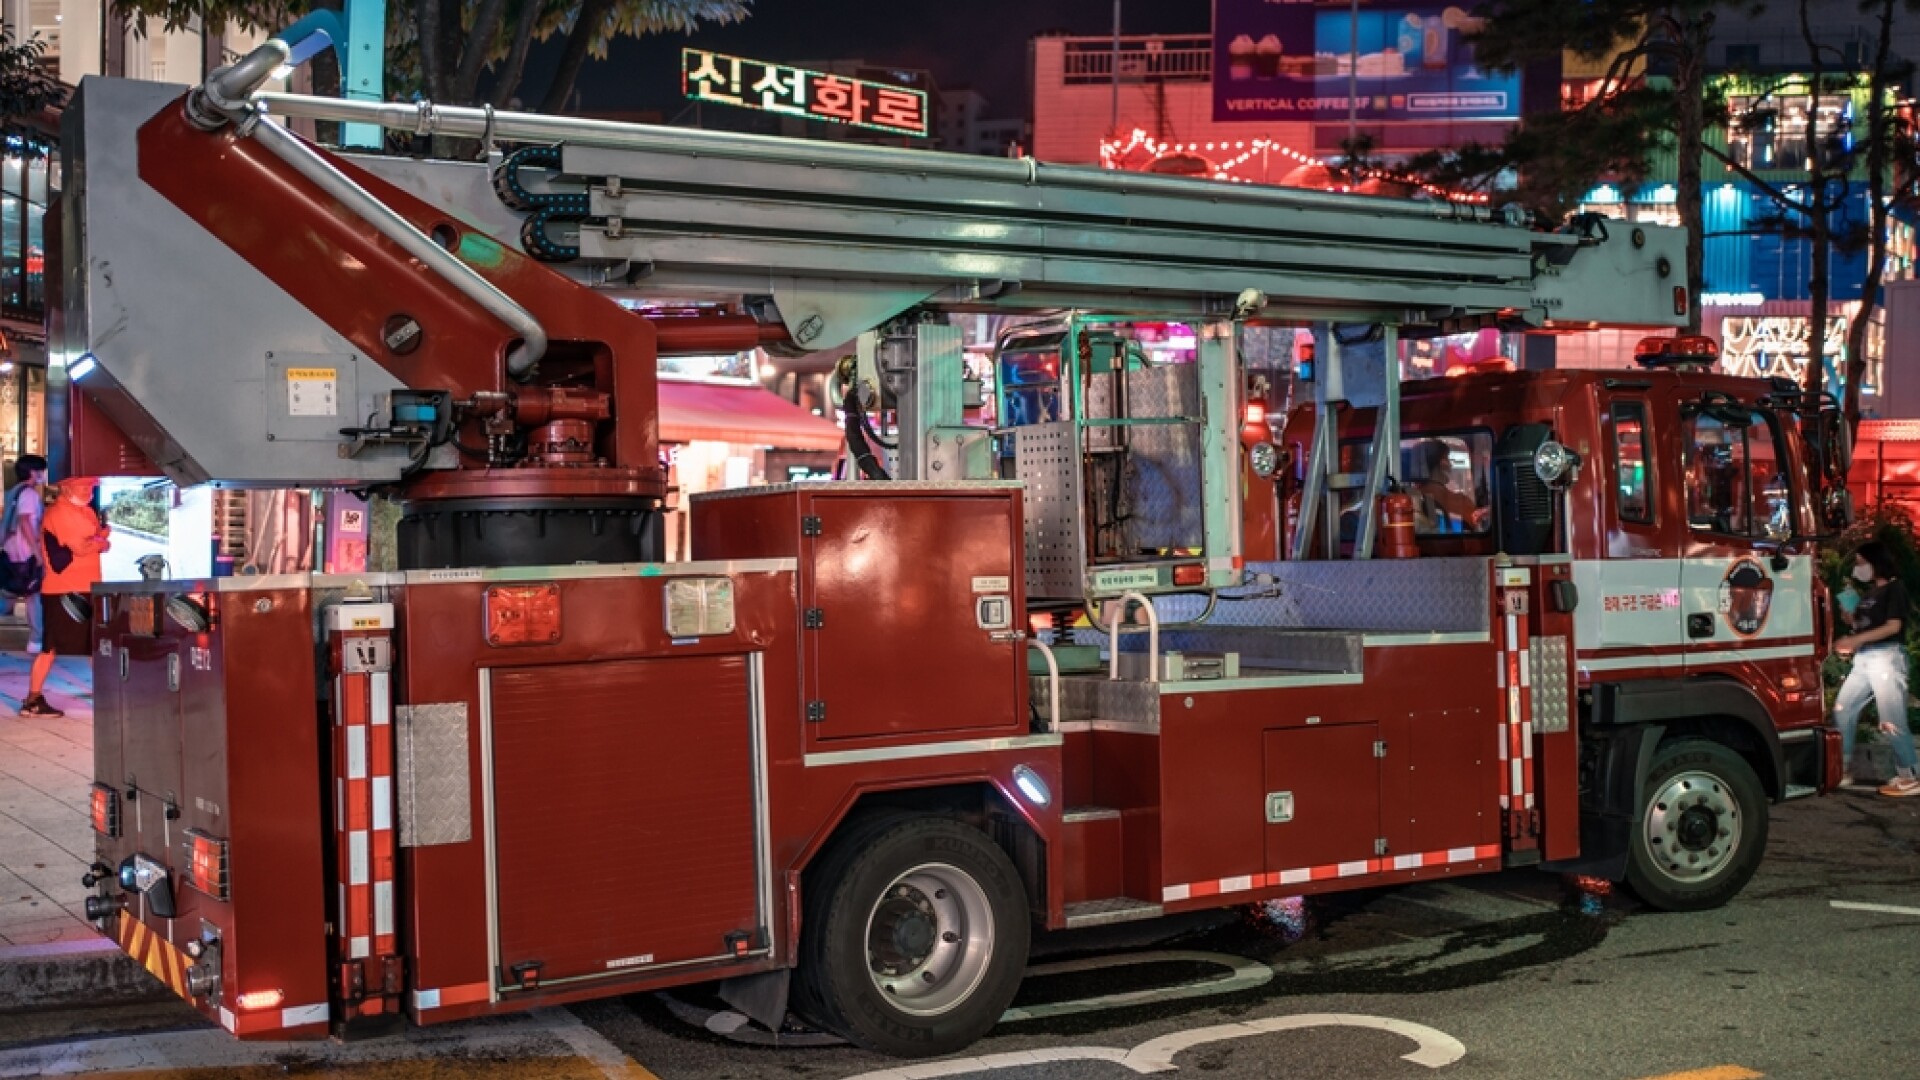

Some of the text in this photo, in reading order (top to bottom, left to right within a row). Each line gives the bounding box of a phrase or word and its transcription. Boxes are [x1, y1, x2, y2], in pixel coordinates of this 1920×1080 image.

[688, 53, 924, 130] 신선화로
[1226, 99, 1294, 110] VERTICAL
[1298, 97, 1350, 109] COFFEE
